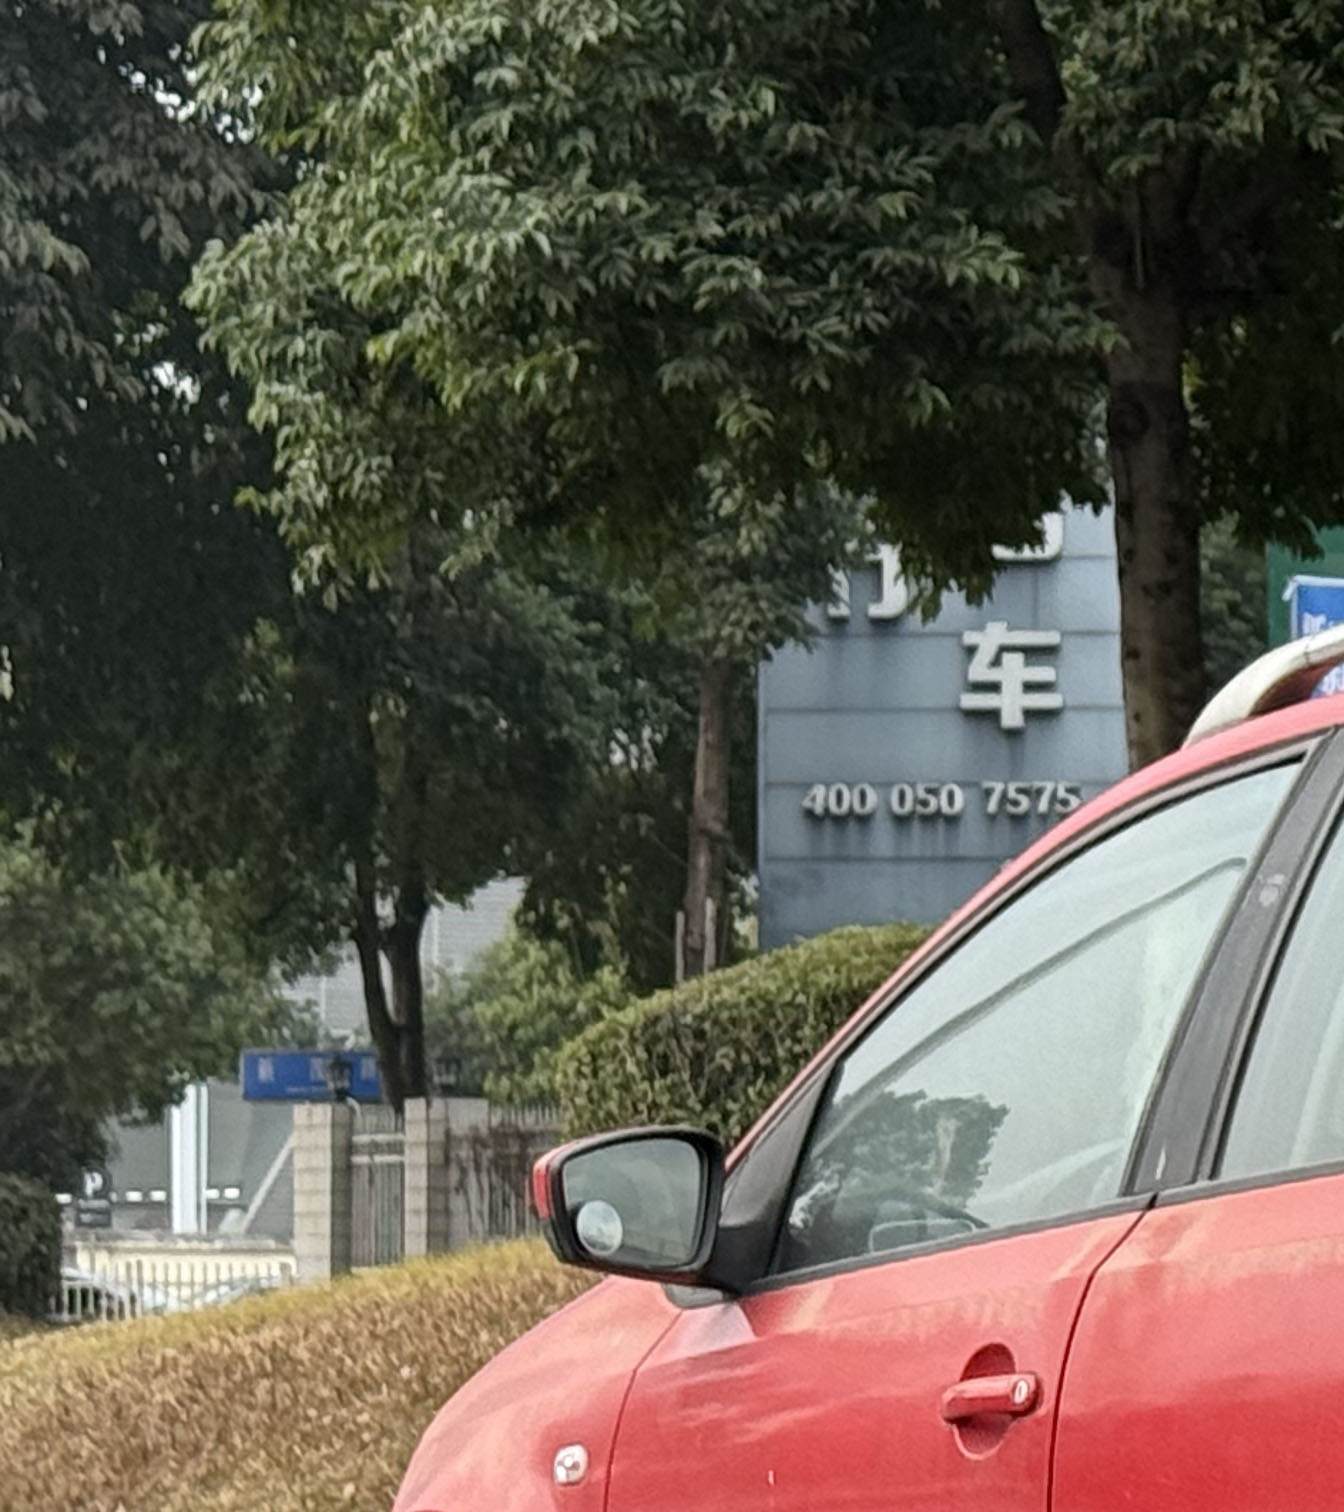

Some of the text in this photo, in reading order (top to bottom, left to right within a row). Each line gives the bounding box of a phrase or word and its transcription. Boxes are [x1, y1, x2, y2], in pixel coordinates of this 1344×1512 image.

[960, 620, 1063, 729] 车
[802, 781, 1082, 816] 400 050 7575
